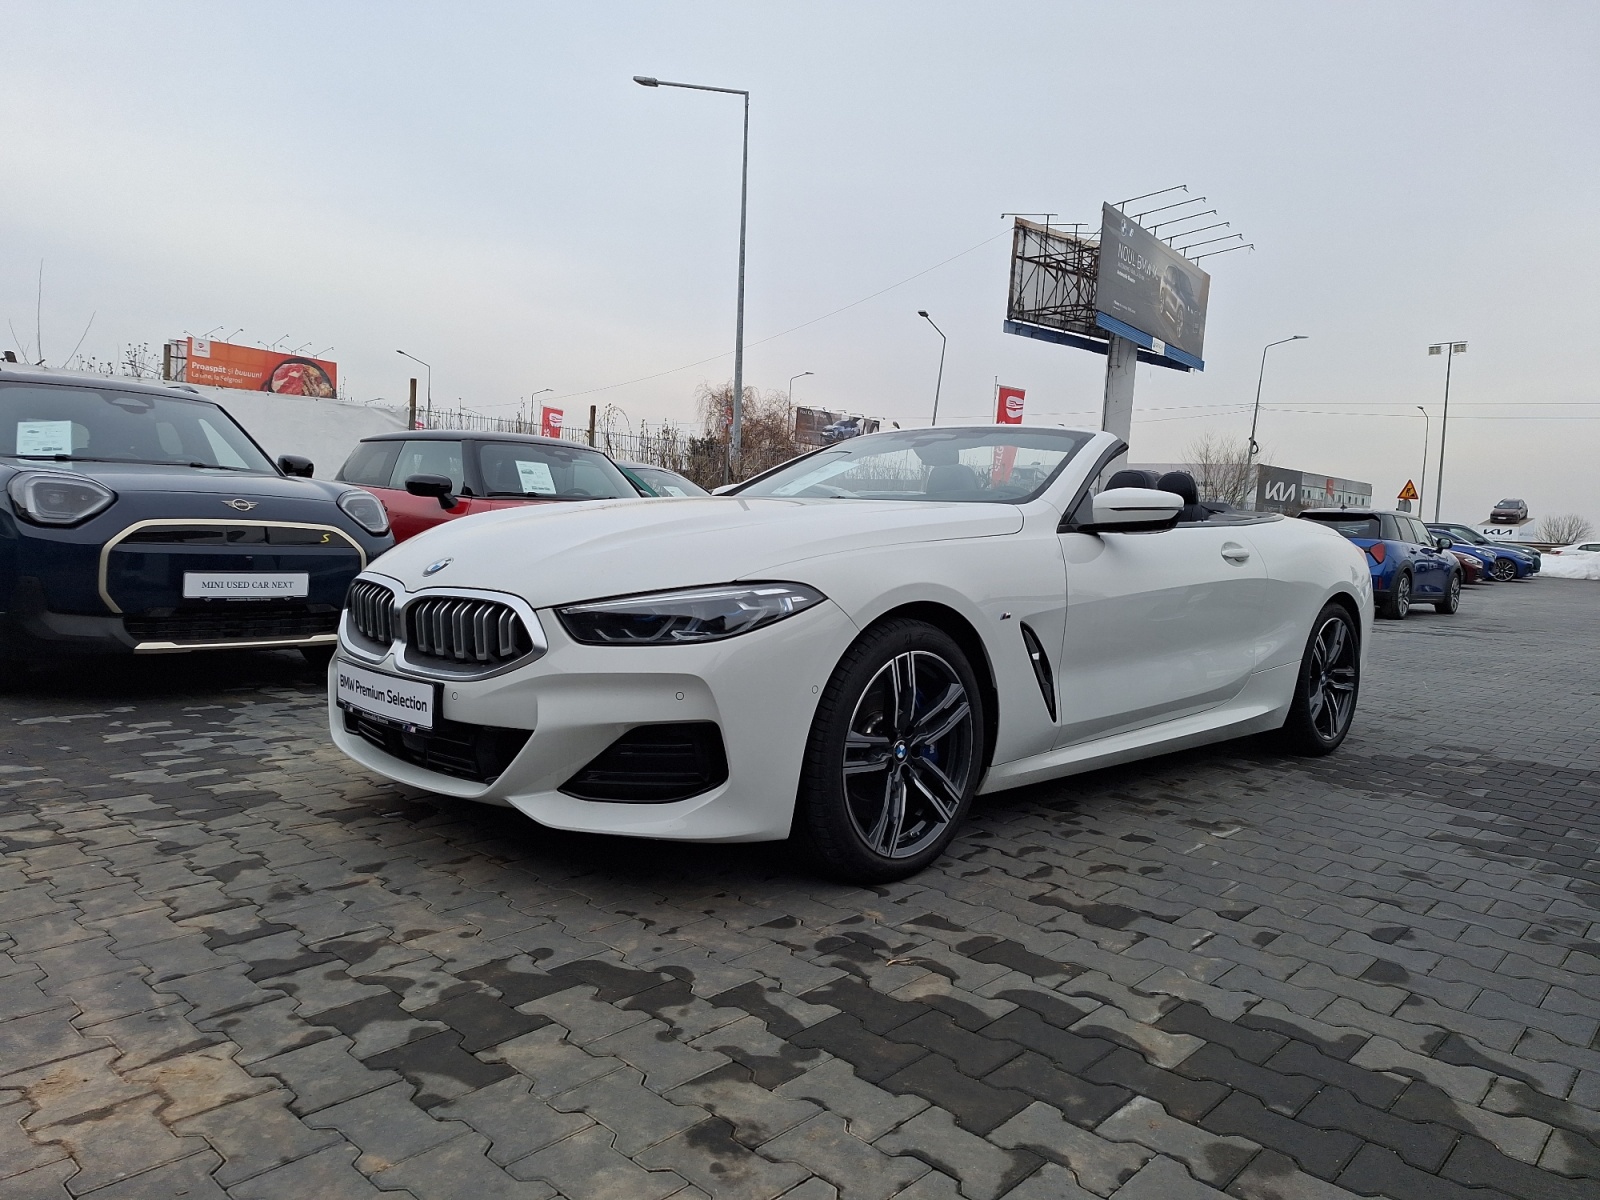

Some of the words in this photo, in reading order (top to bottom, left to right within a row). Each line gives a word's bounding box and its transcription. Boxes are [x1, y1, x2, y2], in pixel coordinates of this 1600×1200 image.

[320, 533, 331, 543] S
[201, 581, 225, 589] MINI
[226, 581, 250, 589] USED
[252, 581, 270, 589] CAR
[271, 581, 295, 589] NEXT
[340, 674, 355, 692] BMW
[355, 680, 386, 702] Premium
[386, 689, 428, 712] Selection
